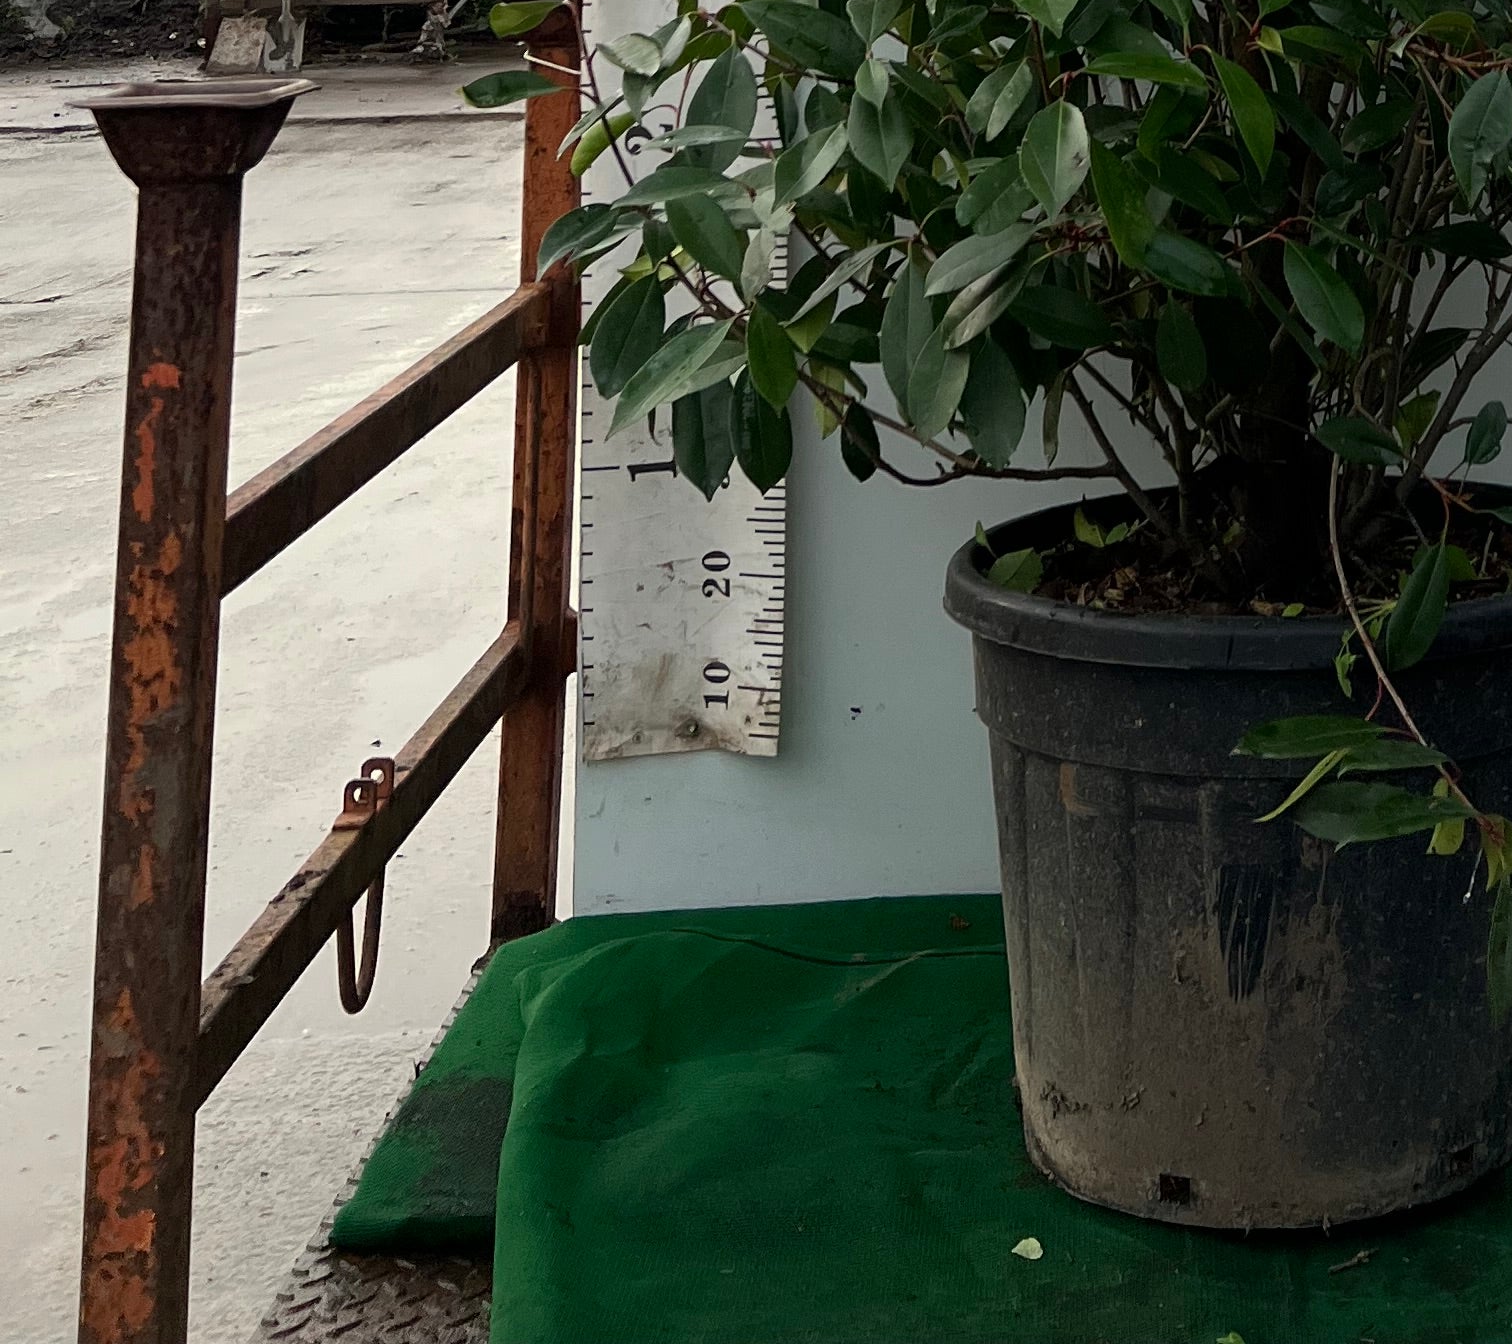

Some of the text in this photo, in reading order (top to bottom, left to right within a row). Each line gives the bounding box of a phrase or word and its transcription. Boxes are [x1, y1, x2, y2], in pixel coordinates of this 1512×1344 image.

[627, 455, 677, 483] 1
[701, 550, 731, 598] 20
[703, 662, 731, 710] 10
